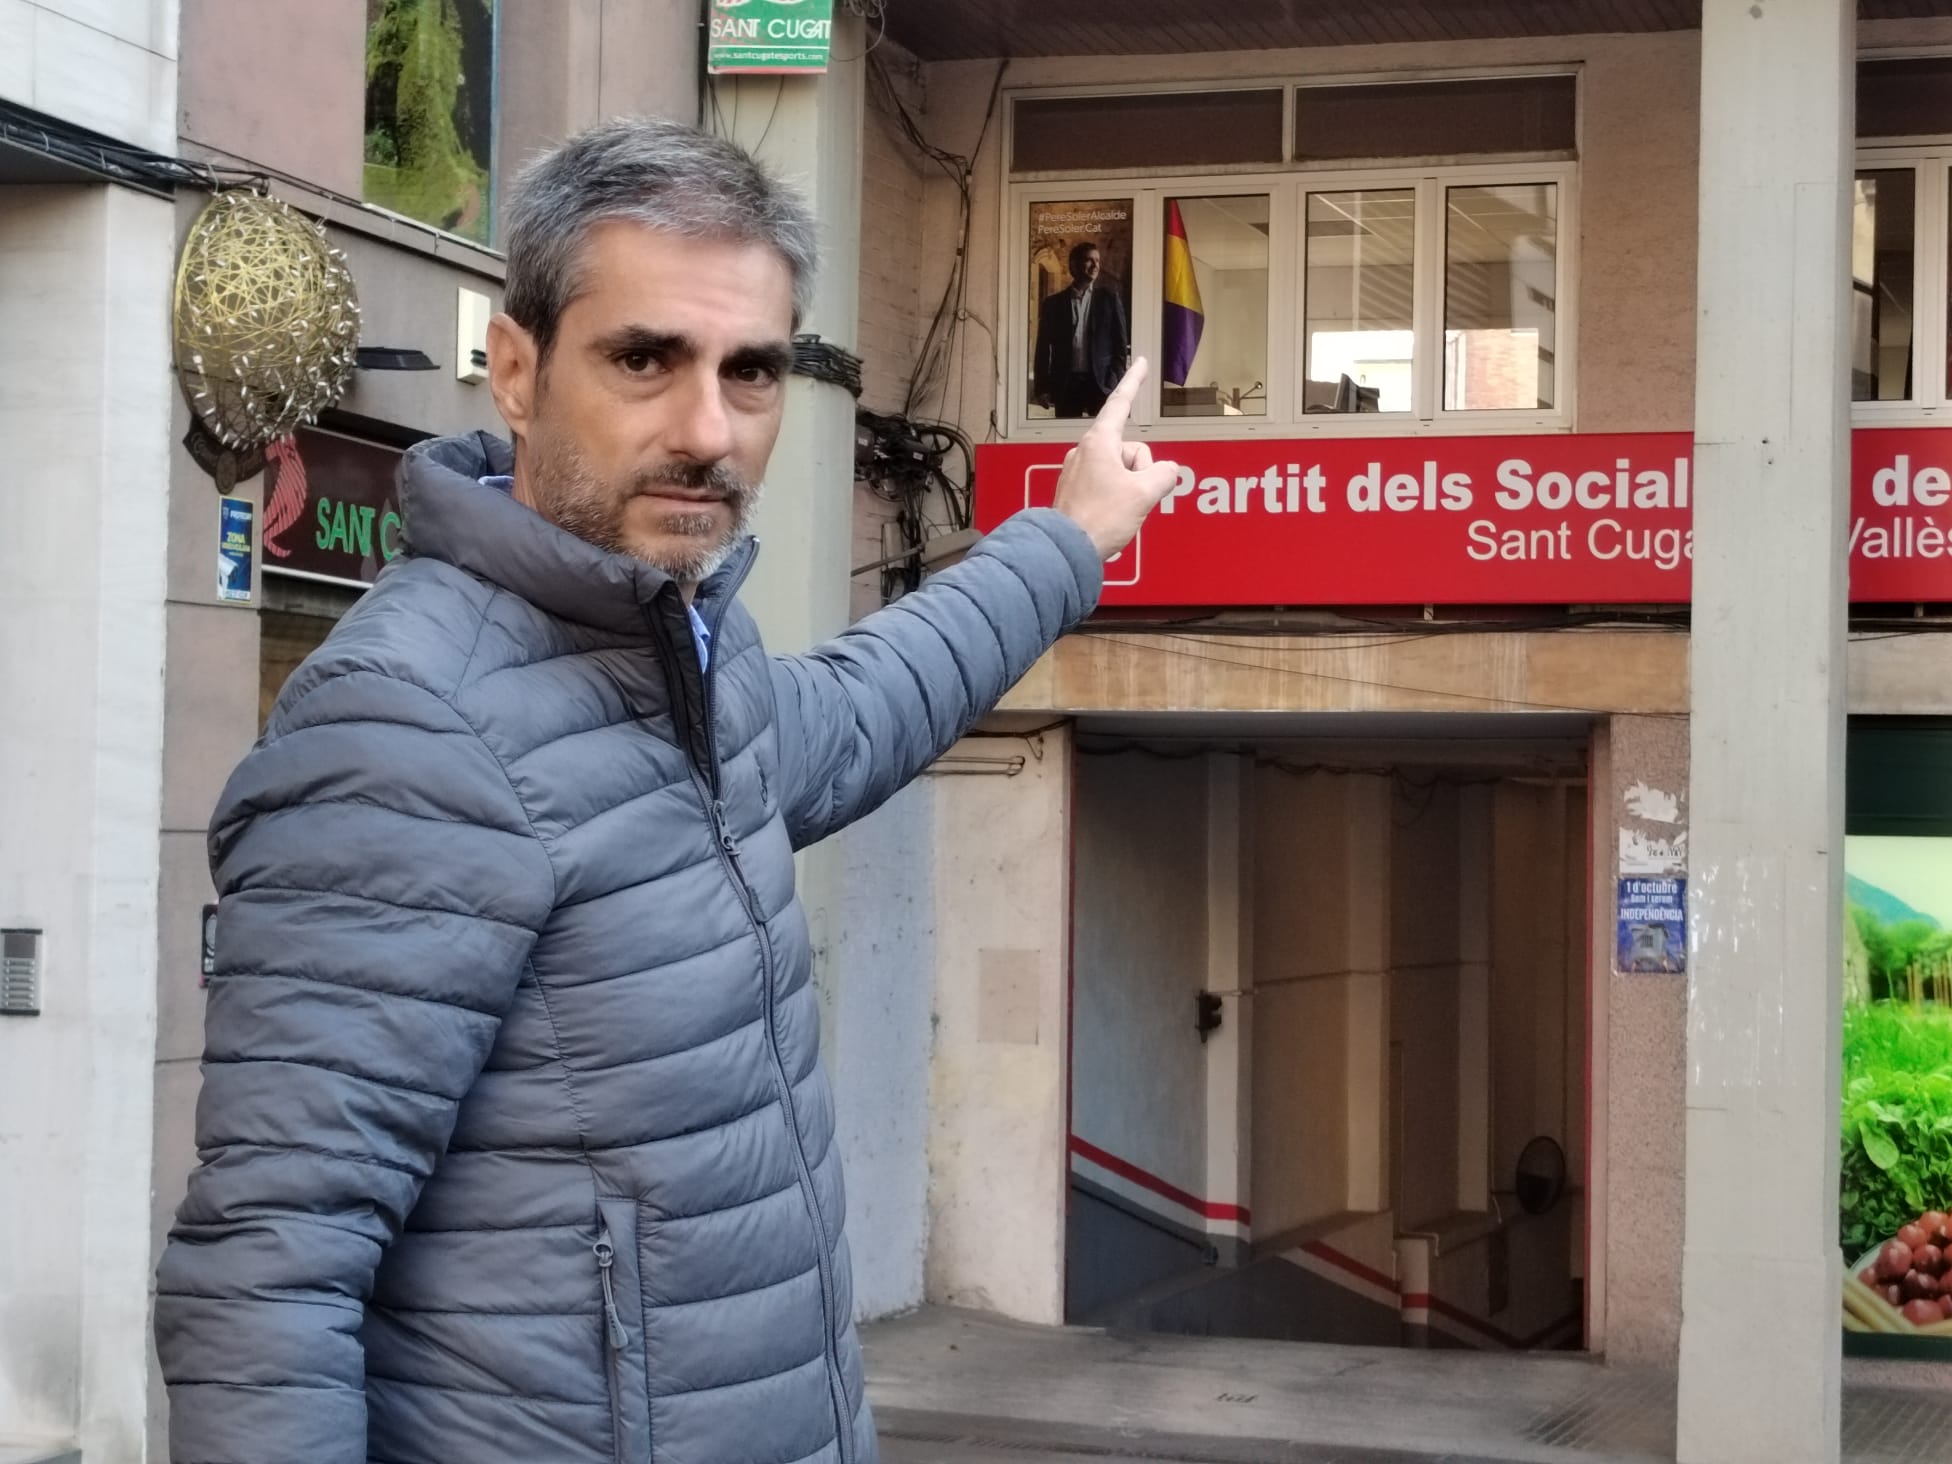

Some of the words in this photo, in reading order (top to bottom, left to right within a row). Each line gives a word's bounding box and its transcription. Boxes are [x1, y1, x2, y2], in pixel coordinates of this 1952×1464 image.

[711, 18, 761, 38] SANT
[767, 19, 831, 39] CUGAT
[1160, 463, 1326, 514] Partit
[1346, 461, 1473, 512] dels
[1872, 455, 1952, 507] de
[316, 497, 375, 557] SANT
[1467, 519, 1571, 560] Sant
[1626, 882, 1631, 893] 1
[1632, 881, 1678, 893] d'octubre
